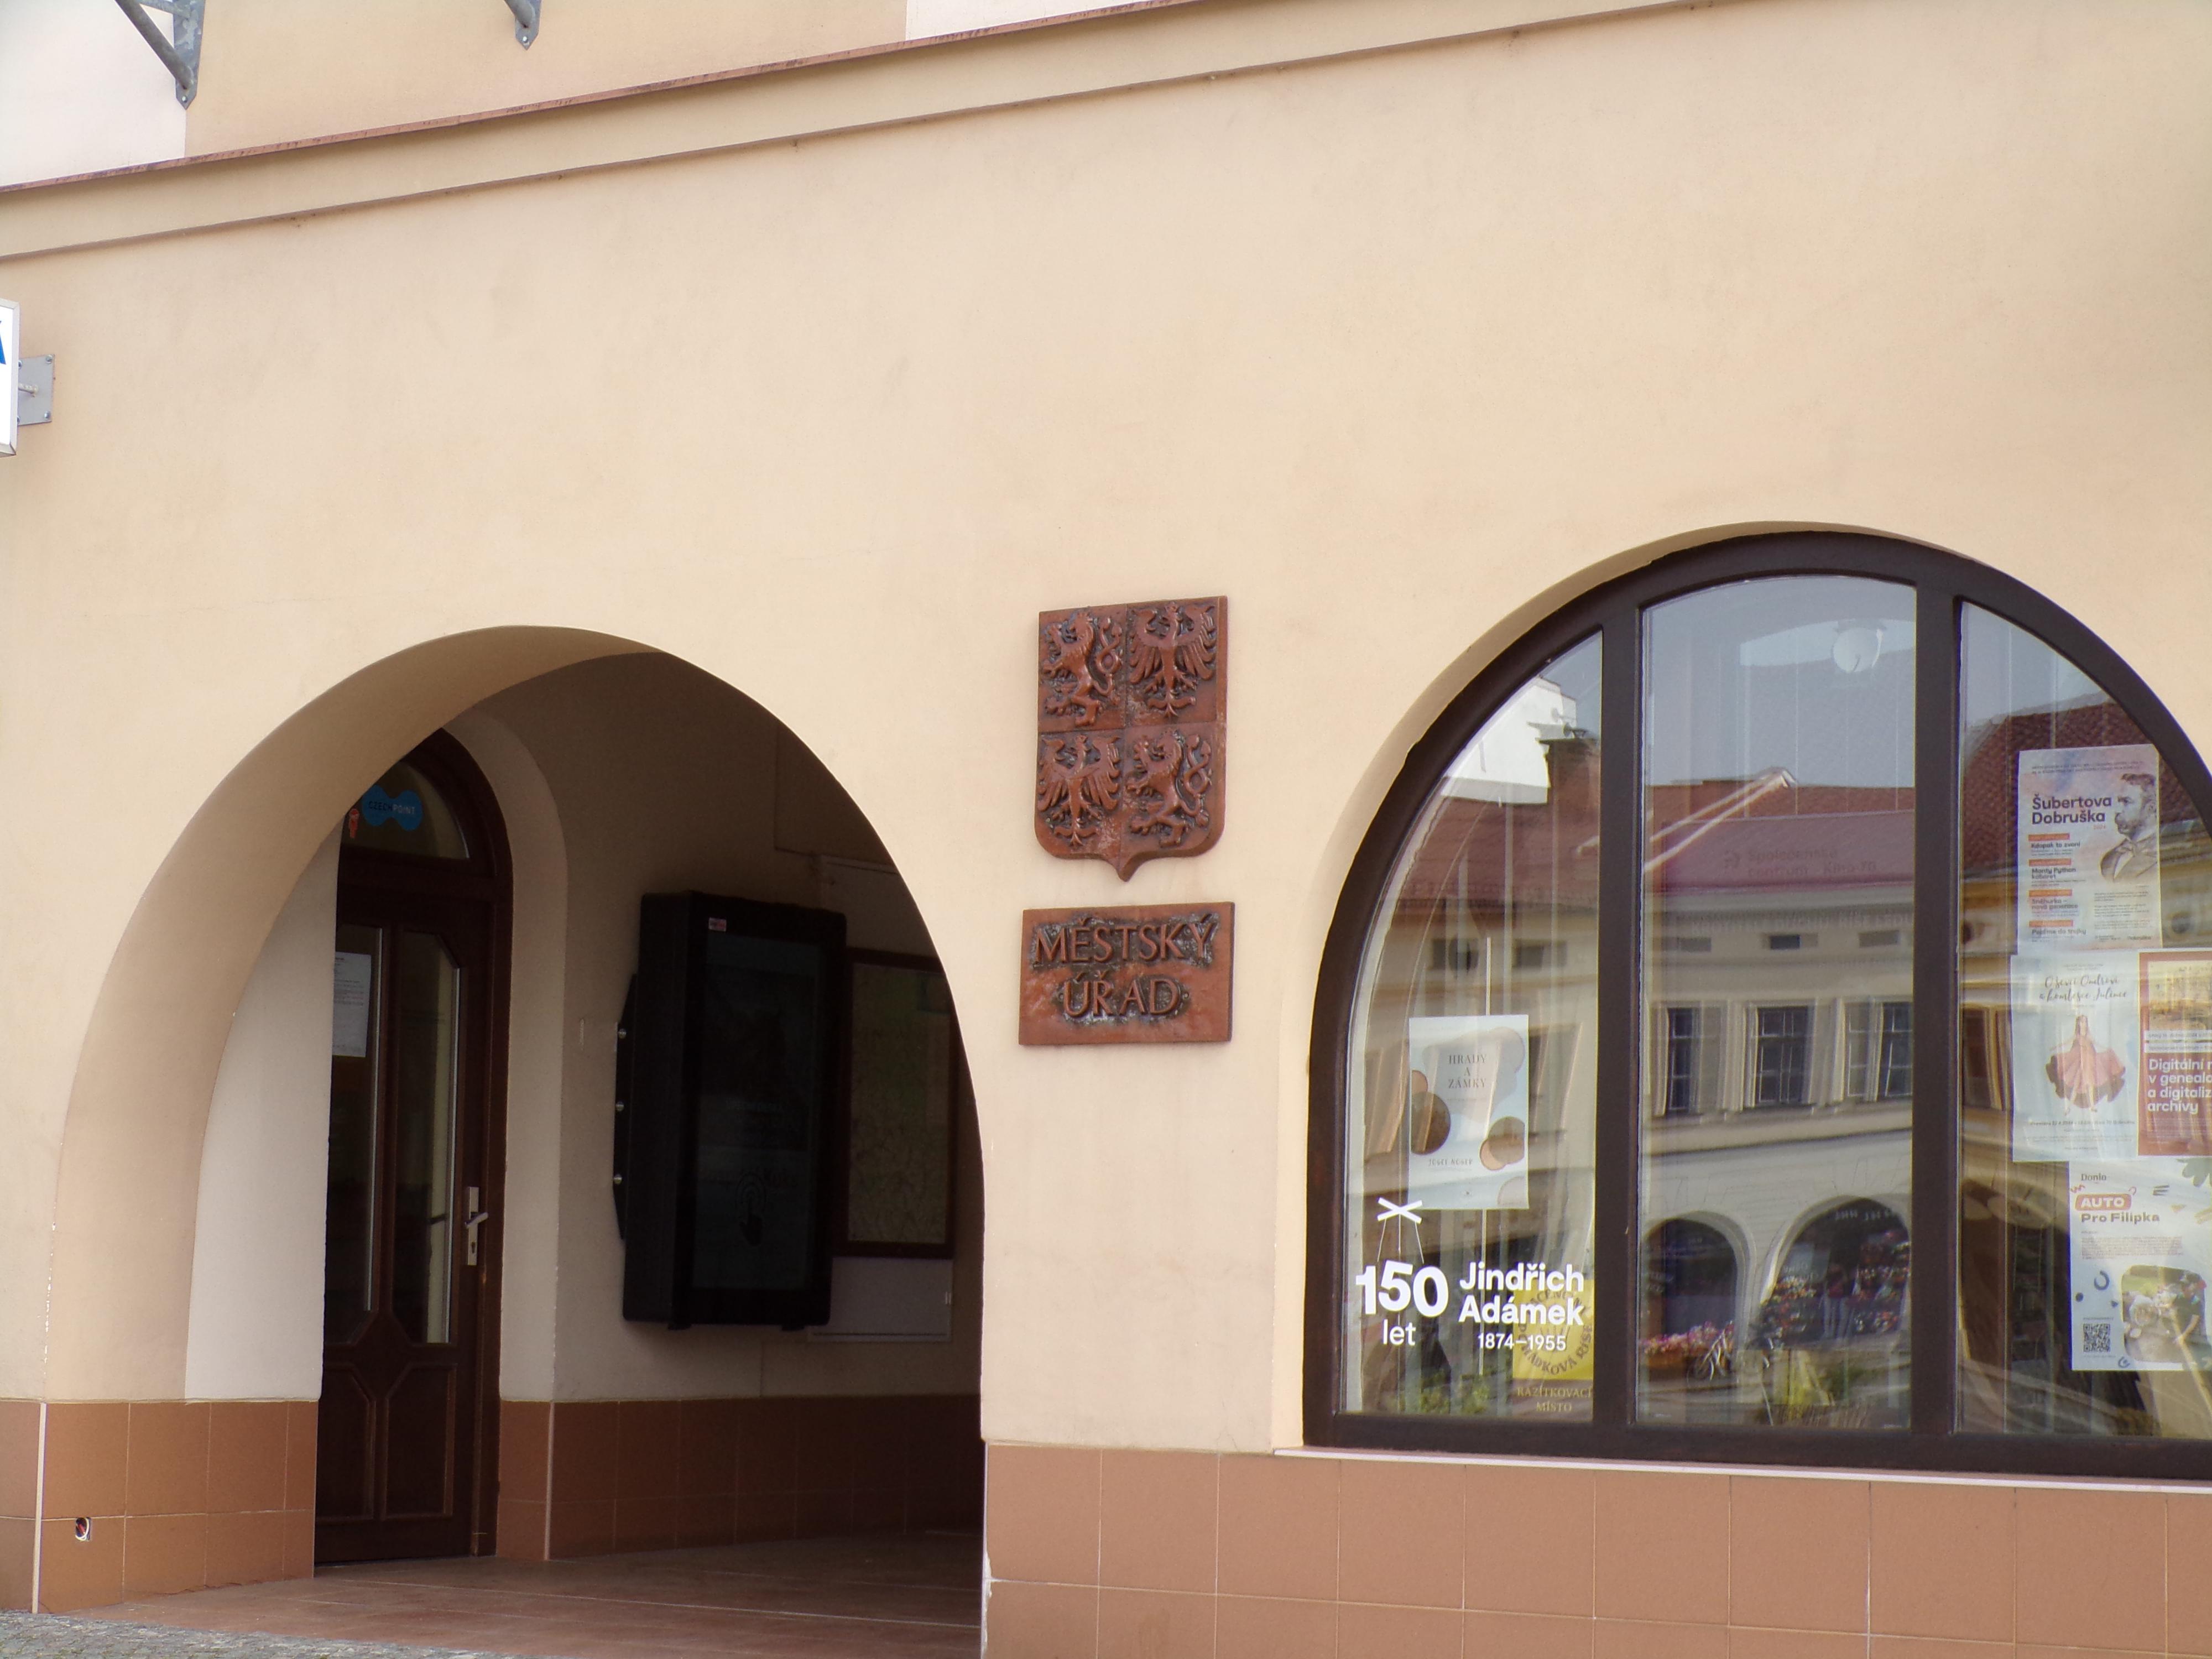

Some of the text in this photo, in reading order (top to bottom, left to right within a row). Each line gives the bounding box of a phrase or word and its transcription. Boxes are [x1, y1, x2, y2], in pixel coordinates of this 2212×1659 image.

[2032, 794, 2112, 810] Šubertova
[2032, 809, 2106, 825] Dobruška
[1034, 912, 1215, 964] MĚSTSKÝ
[1062, 970, 1182, 1018] ÚŘAD
[1448, 1054, 1487, 1065] HRADY
[2148, 1058, 2204, 1073] Digitální
[1464, 1067, 1471, 1076] A
[2148, 1074, 2157, 1083] v
[1448, 1077, 1487, 1089] ZÁMKY
[2147, 1089, 2156, 1098] a
[2081, 1197, 2125, 1208] AUTO
[2081, 1212, 2160, 1225] Pro Filipka
[1459, 1261, 1584, 1292] Jindřich
[1355, 1260, 1448, 1317] 150
[1458, 1294, 1585, 1326] Adámek
[1383, 1319, 1416, 1347] let
[1517, 1385, 1593, 1399] RAZÍTKOVACÍ
[1536, 1400, 1573, 1412] MÍSTO
